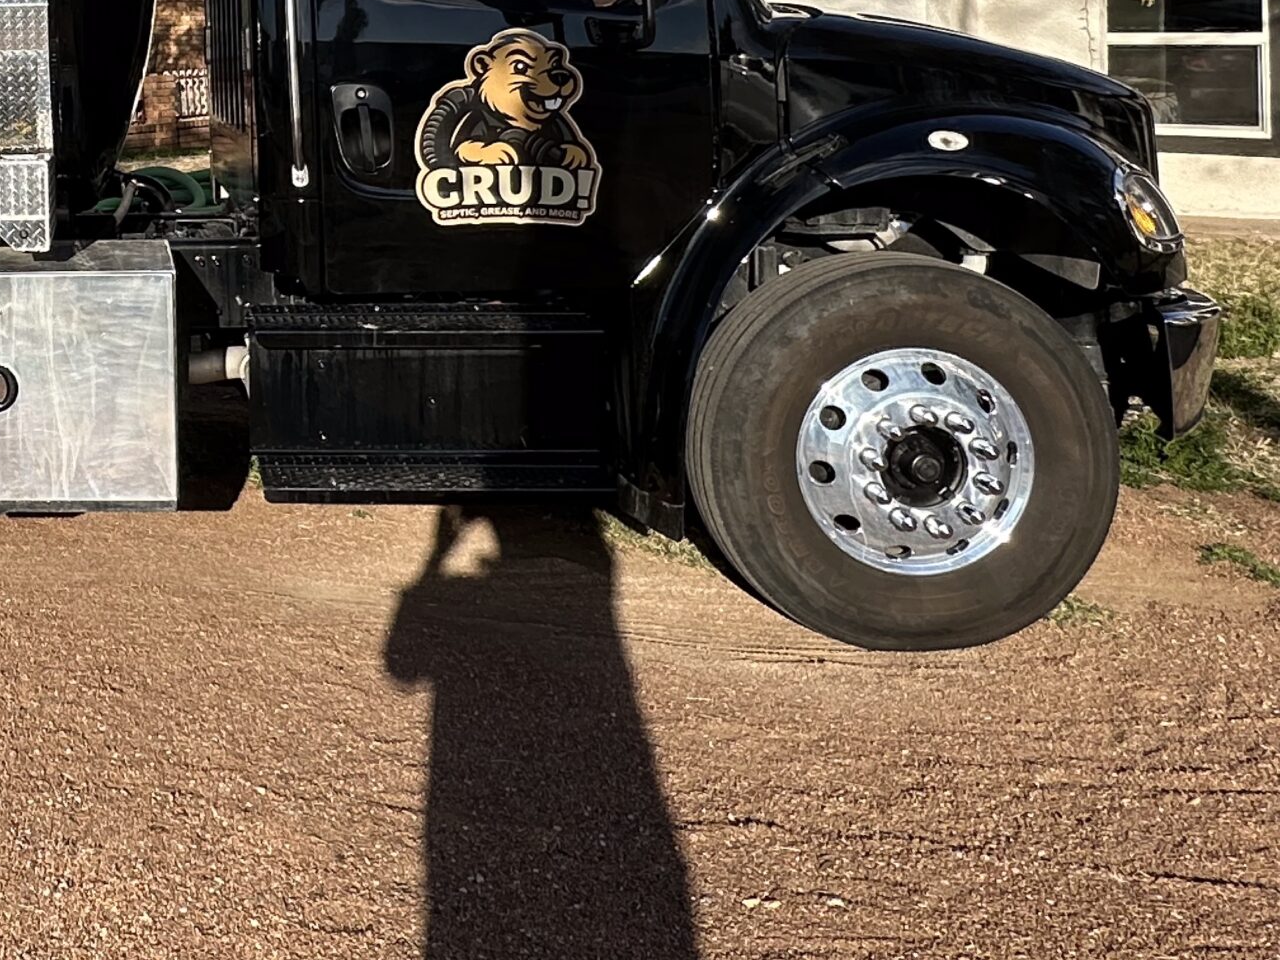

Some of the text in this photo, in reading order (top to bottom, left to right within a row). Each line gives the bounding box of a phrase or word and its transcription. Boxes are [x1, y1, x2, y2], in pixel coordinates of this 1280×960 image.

[423, 165, 594, 209] CRUD!
[439, 207, 580, 219] SEPTIC, GREASE, AND MORE
